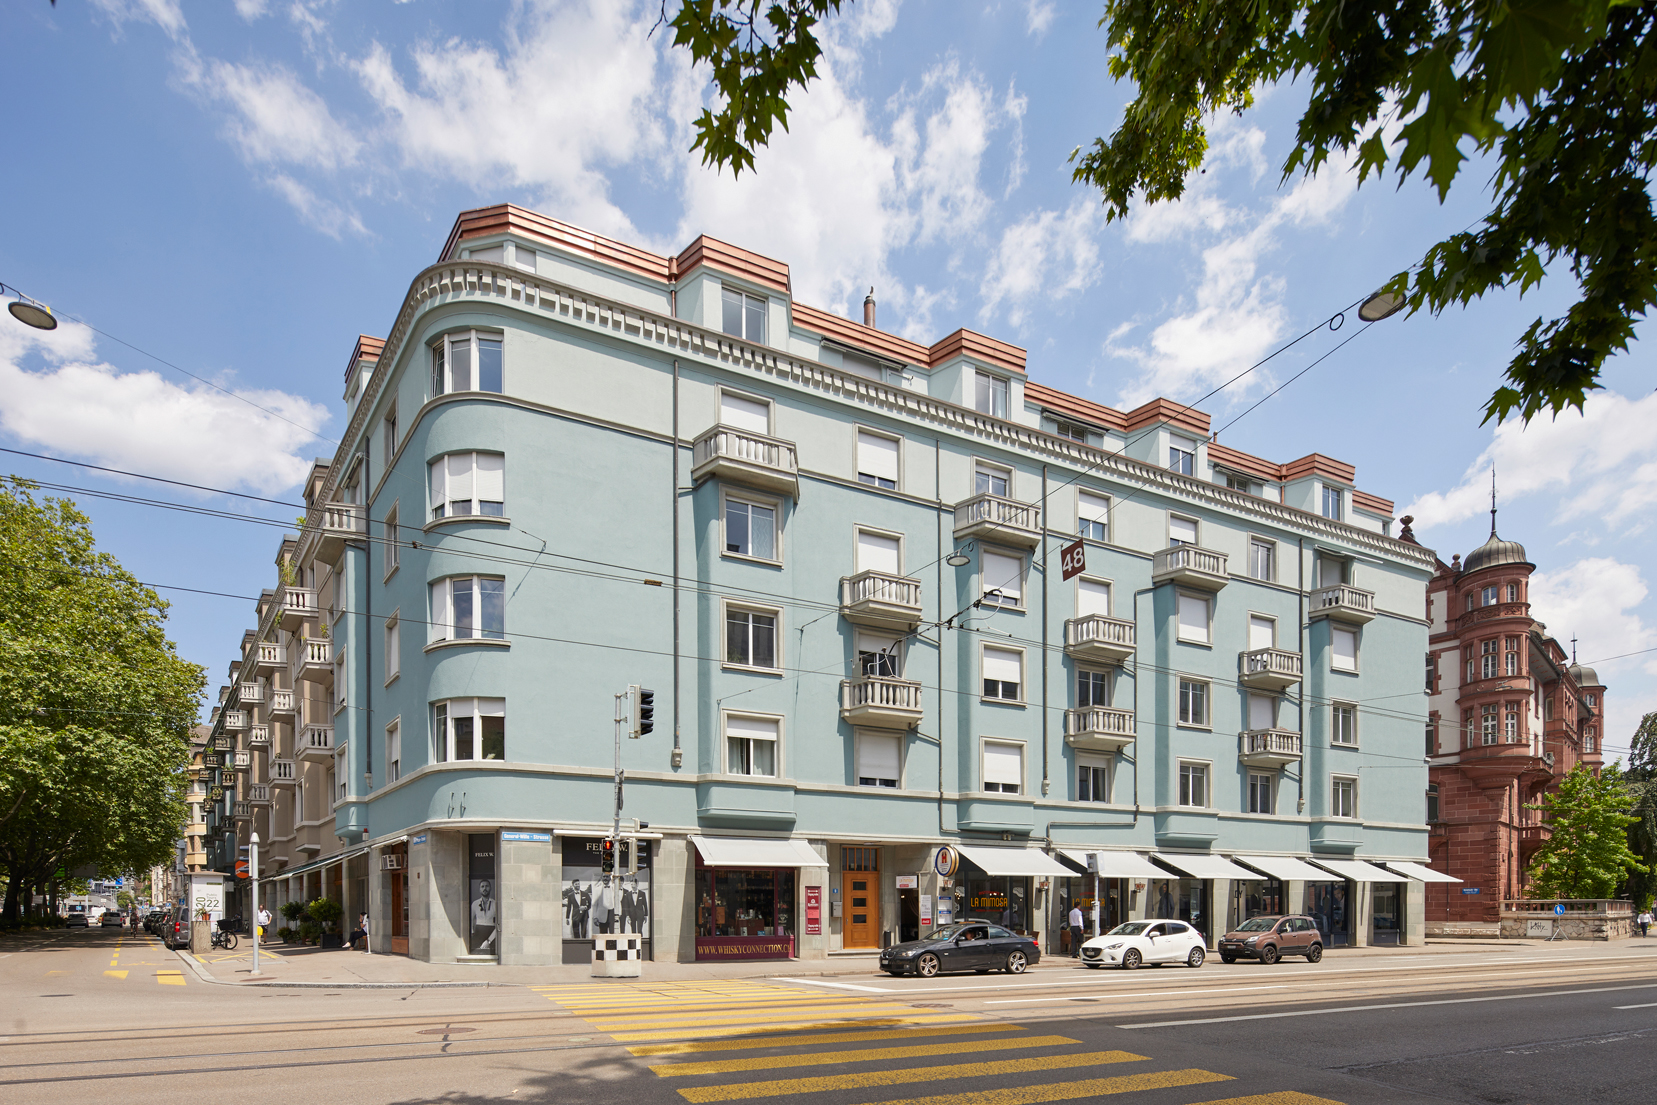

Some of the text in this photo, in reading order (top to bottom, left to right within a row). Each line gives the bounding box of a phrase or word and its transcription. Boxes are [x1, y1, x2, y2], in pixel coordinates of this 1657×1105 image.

[1063, 547, 1084, 572] 48
[970, 897, 1008, 907] LA MIMOSA
[697, 943, 792, 955] WWW.WHISKYCONNECTION.CH
